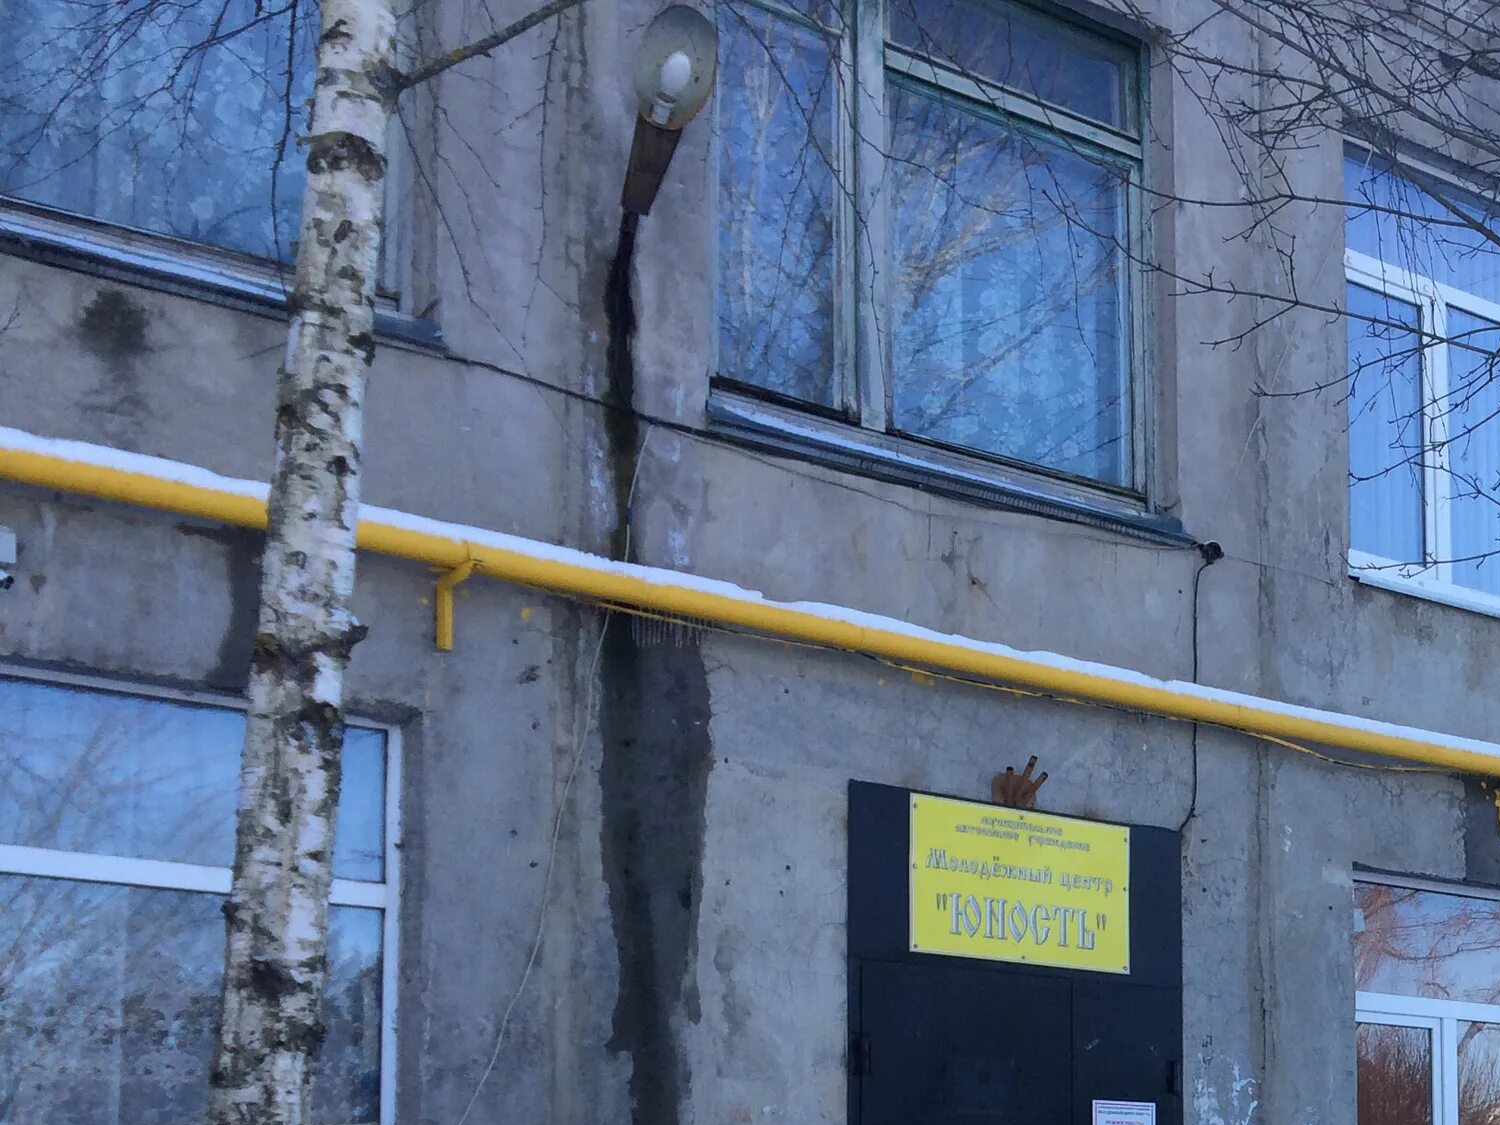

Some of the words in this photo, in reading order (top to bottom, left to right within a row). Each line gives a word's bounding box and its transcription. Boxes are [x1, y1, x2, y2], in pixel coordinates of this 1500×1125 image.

[925, 848, 1053, 884] Молодёжный
[1060, 872, 1114, 898] центр
[935, 891, 1108, 951] "ЮНОСТЬ"
